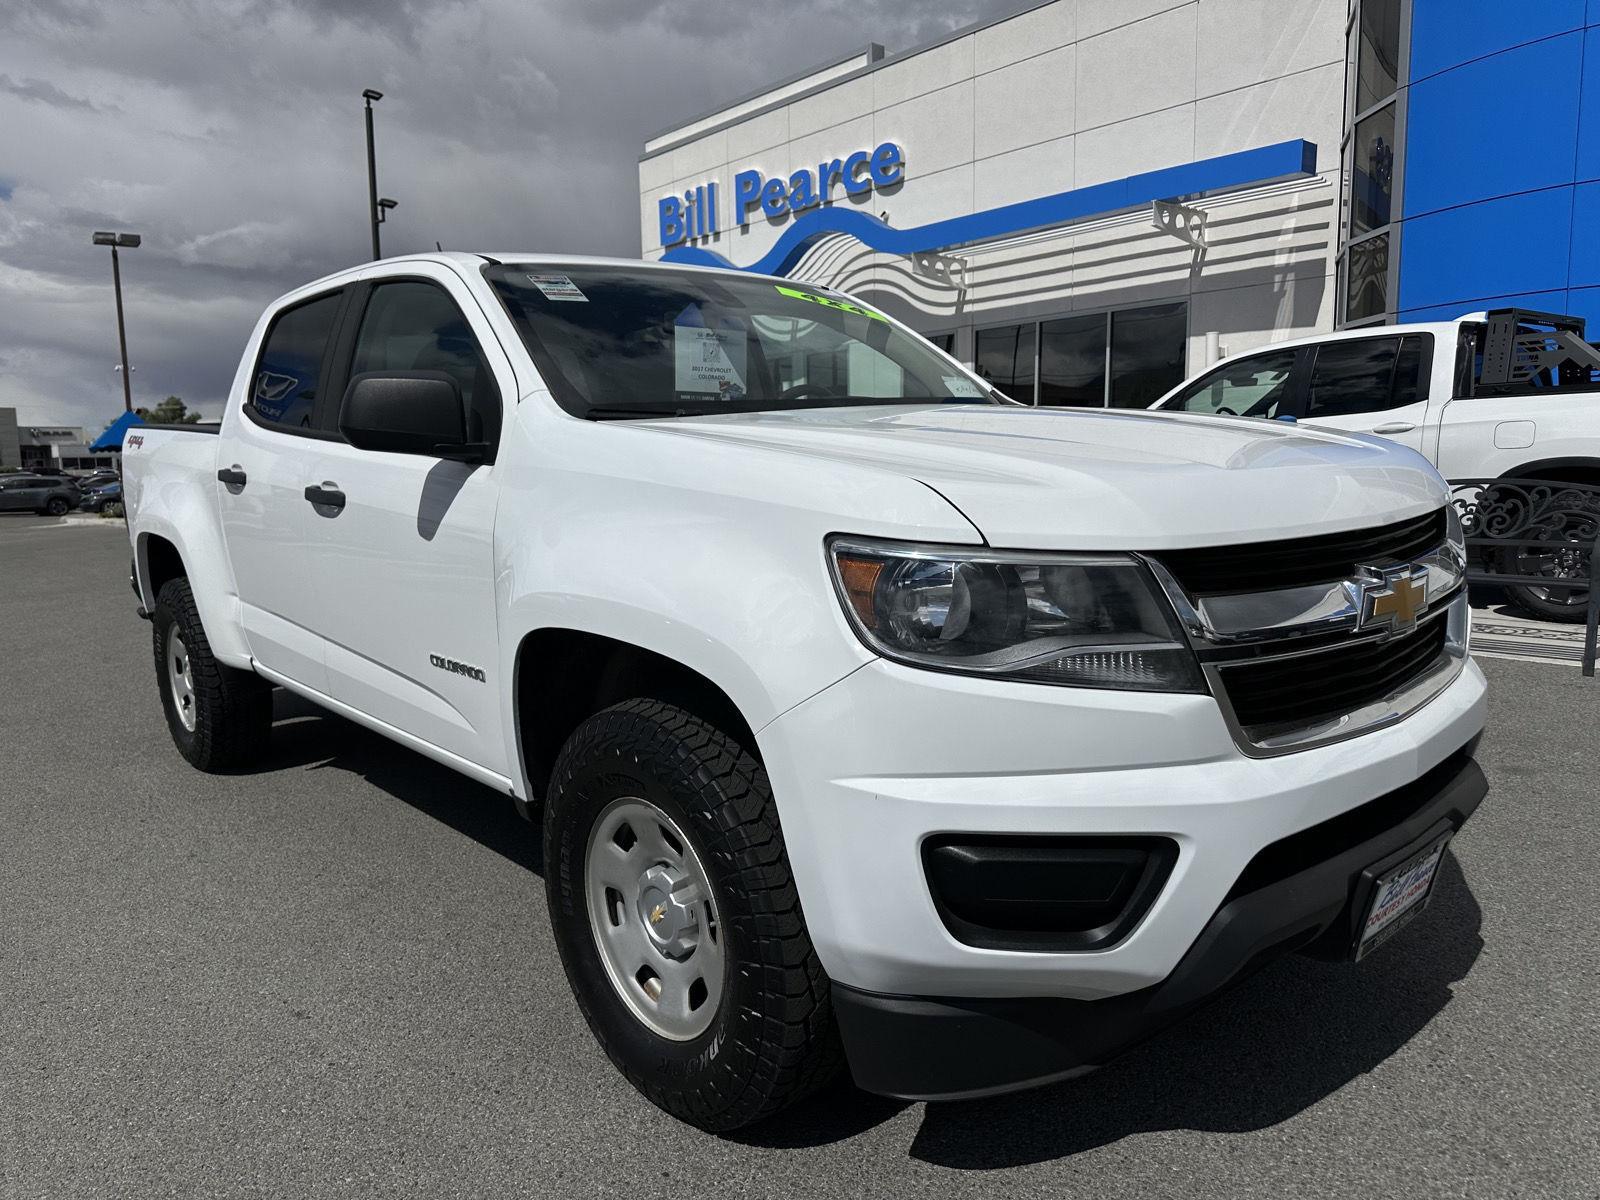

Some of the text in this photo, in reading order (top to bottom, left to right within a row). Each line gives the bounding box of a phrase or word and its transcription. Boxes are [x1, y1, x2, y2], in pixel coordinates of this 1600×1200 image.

[659, 142, 904, 247] Bill Pearce
[429, 653, 487, 684] COLORADO
